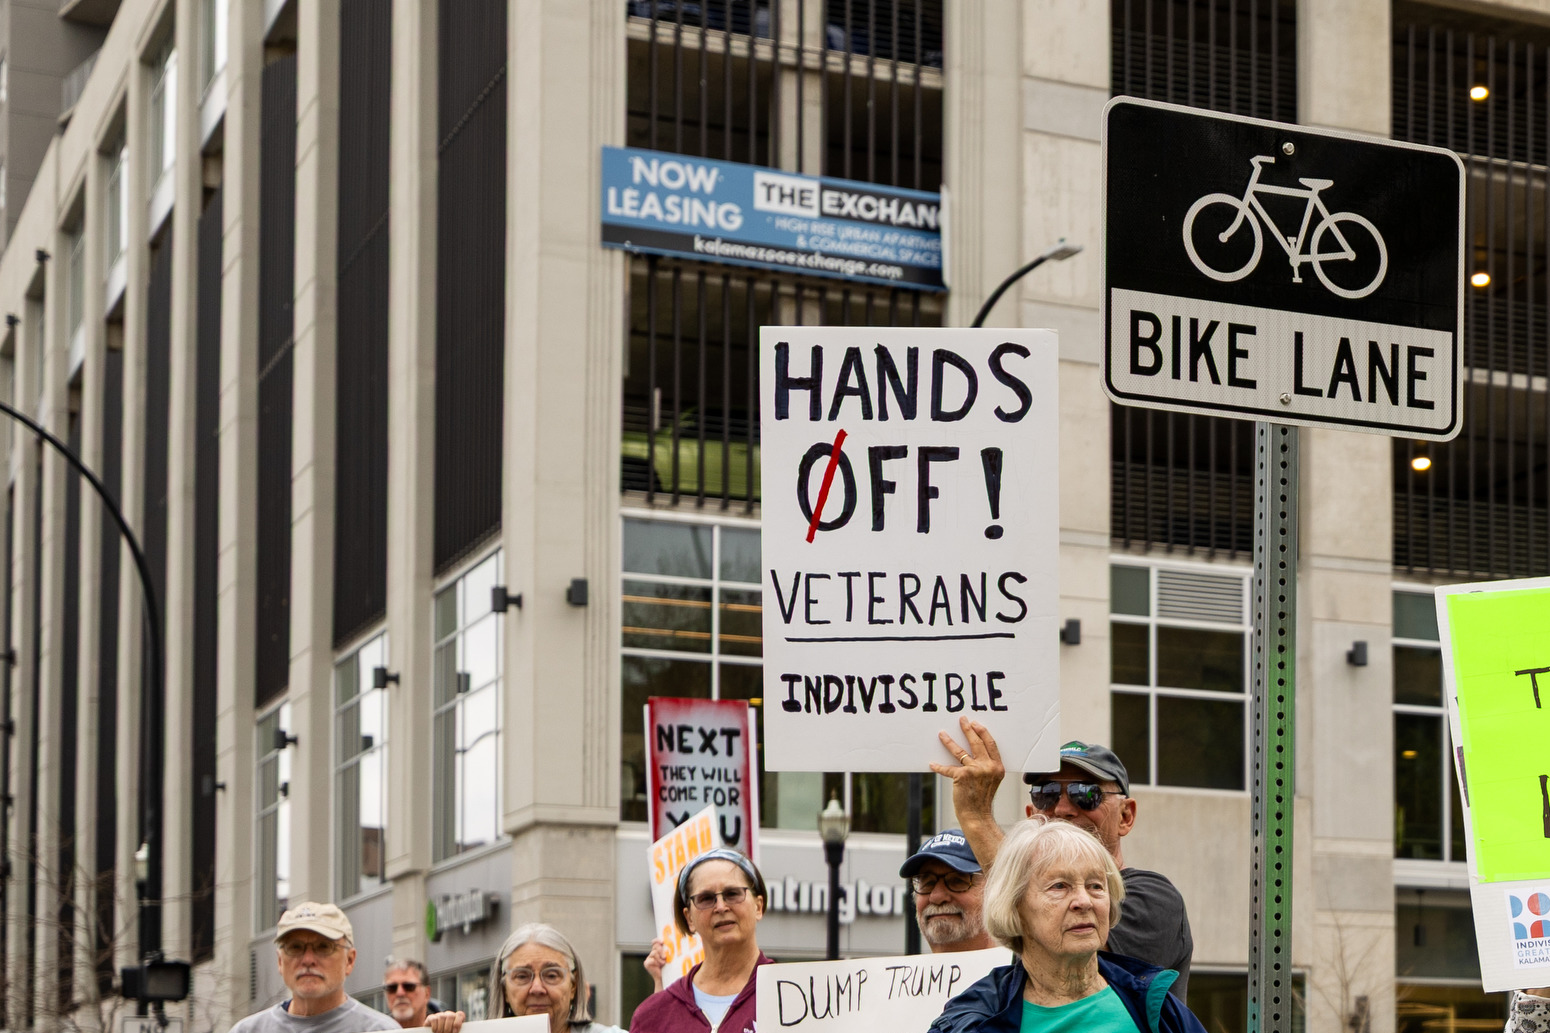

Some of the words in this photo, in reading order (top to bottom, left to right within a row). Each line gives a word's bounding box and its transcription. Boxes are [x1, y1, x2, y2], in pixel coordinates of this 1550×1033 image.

[632, 156, 719, 194] NOW
[759, 180, 815, 209] THE
[608, 186, 743, 231] LEASING
[775, 217, 808, 231] HIGH
[810, 221, 836, 236] RISE
[839, 226, 881, 242] URBAN
[883, 231, 941, 250] APARTME
[809, 235, 898, 259] COMMERCIAL
[694, 235, 903, 280] kalamazooexchange.com
[1129, 309, 1257, 389] BIKE
[1294, 331, 1435, 410] LANE
[774, 341, 1033, 423] HANDS
[770, 569, 1028, 626] VETERANS
[780, 671, 1009, 716] INDIVISIBLE
[656, 724, 741, 757] NEXT
[659, 765, 697, 781] THEY
[701, 767, 742, 783] WILL
[658, 785, 697, 803] COME
[703, 786, 740, 807] FOR
[653, 815, 713, 884] STAND
[665, 811, 741, 847] YU
[776, 968, 868, 1026] DUMP
[885, 964, 961, 1000] TRUMP
